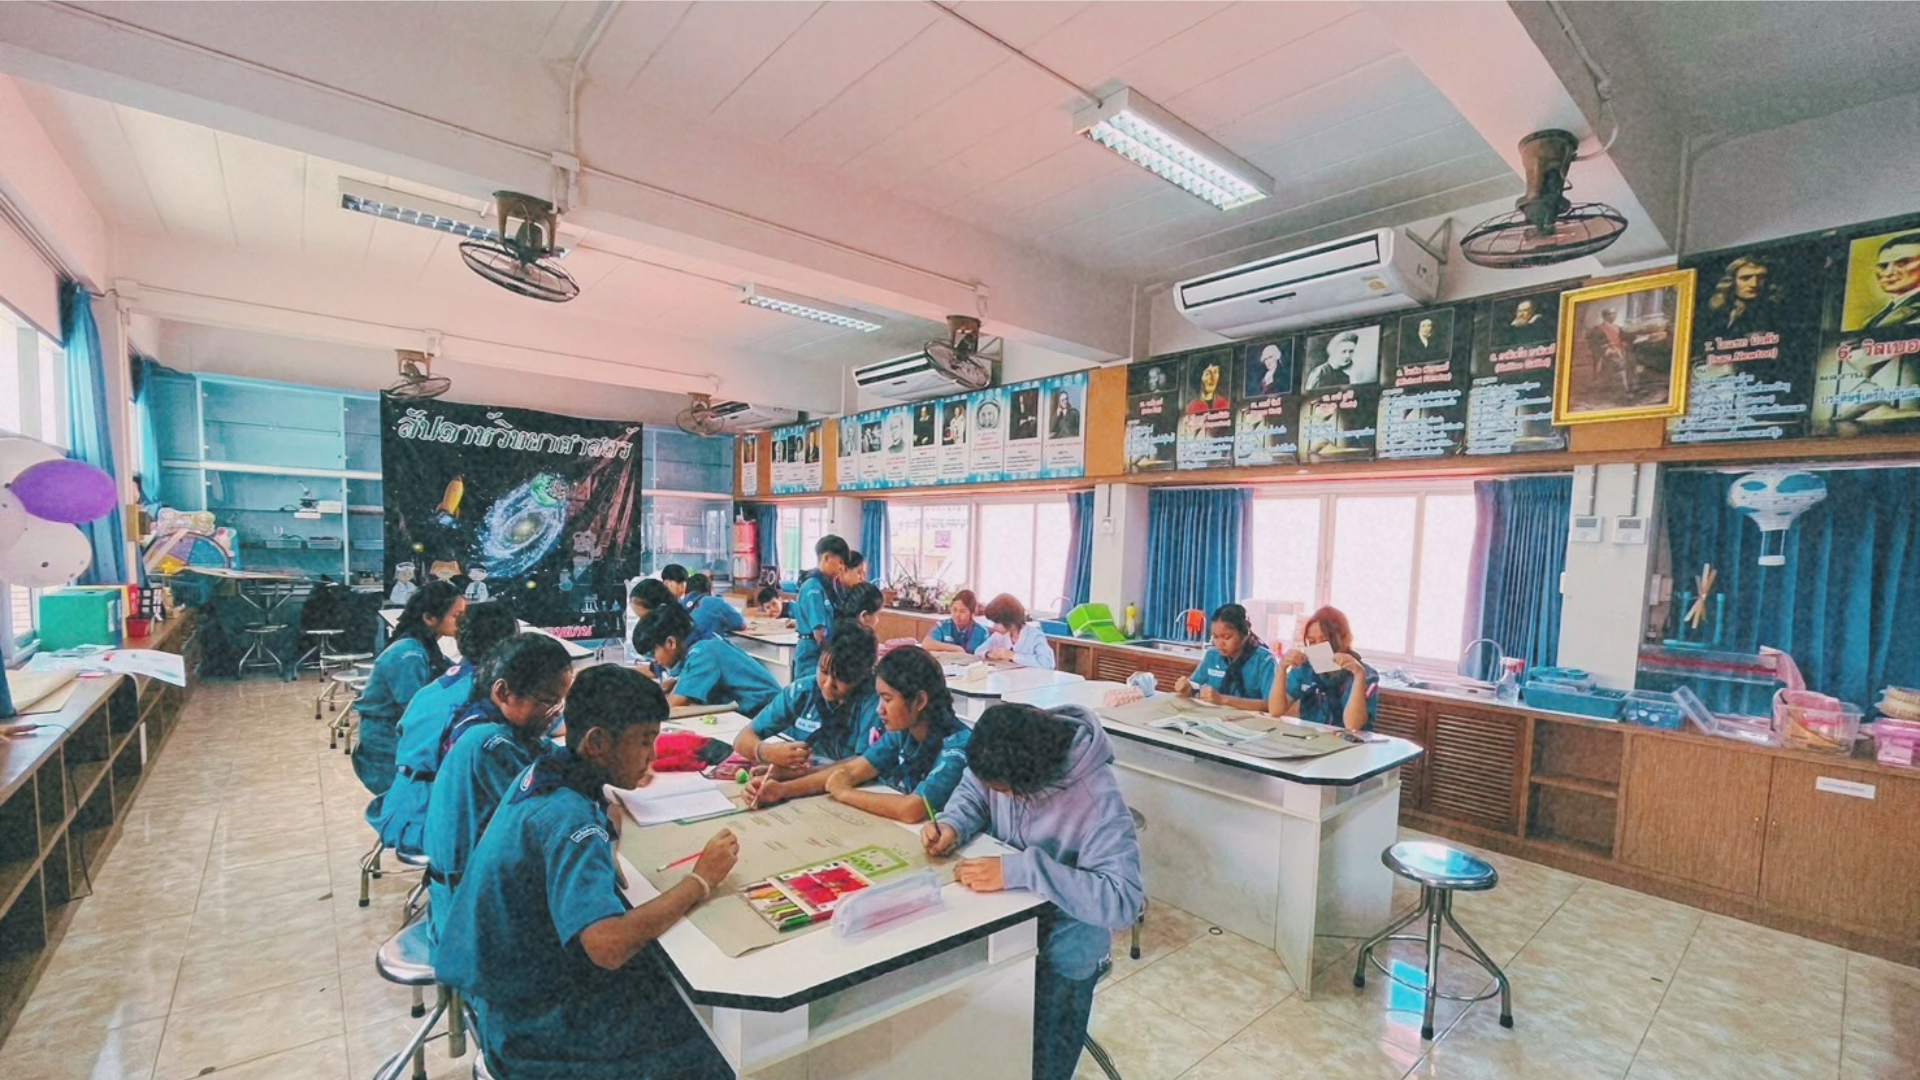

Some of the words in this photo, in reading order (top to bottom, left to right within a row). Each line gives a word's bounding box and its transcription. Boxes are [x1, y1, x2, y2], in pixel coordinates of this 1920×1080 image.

[397, 407, 640, 459] สัปดาห์วิทยาศาสตร์
